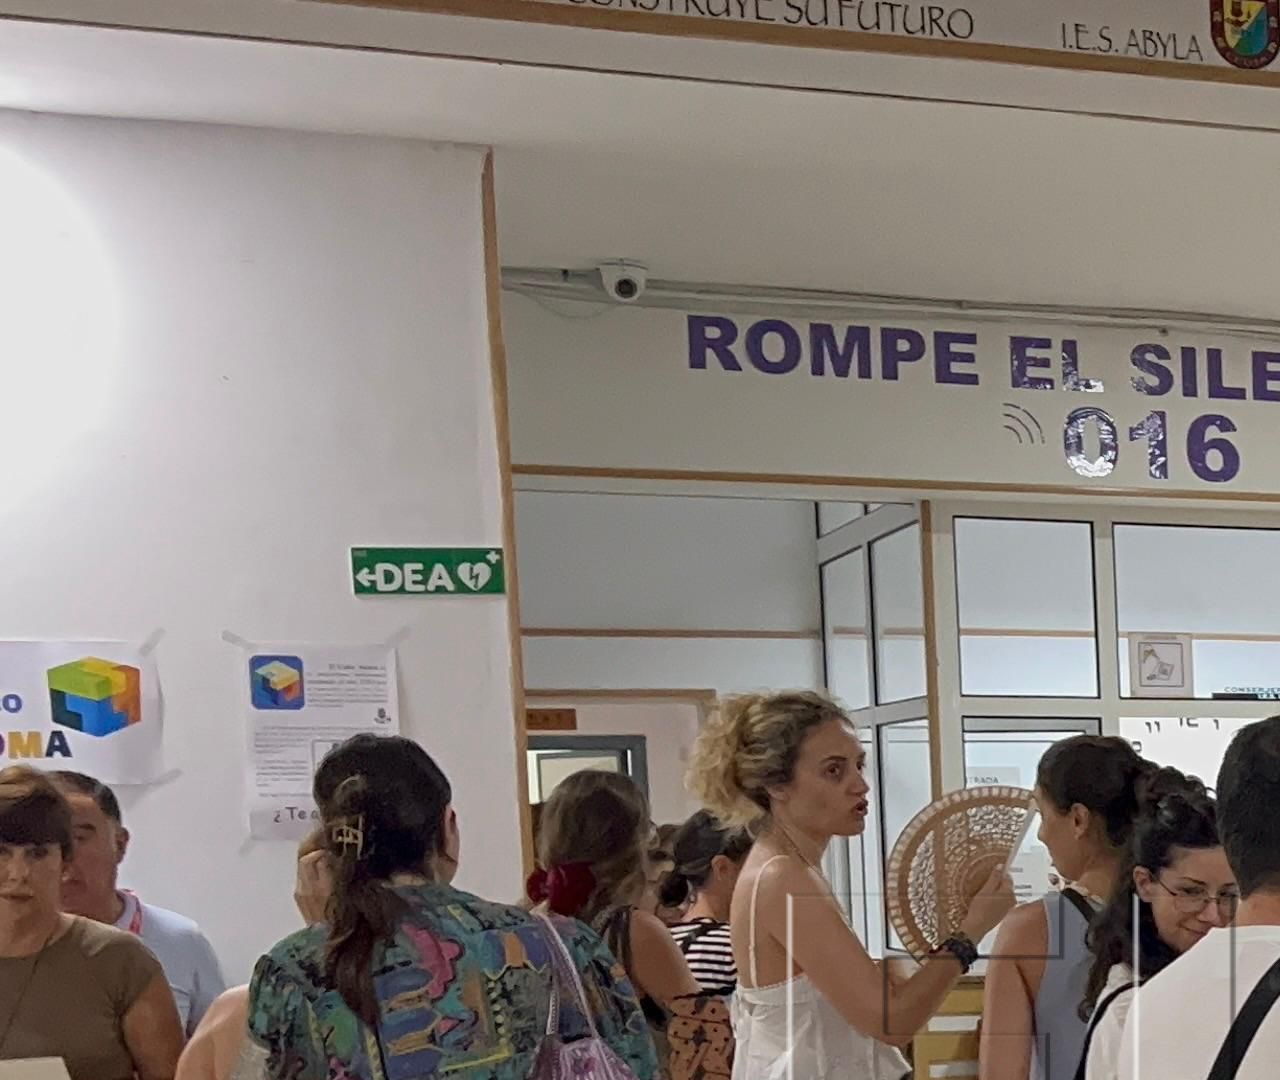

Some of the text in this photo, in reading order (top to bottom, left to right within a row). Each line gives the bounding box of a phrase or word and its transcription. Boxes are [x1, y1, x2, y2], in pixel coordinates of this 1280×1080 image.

[783, 0, 829, 26] SU
[838, 0, 975, 40] FUTURO
[1061, 22, 1119, 52] I.E.S.
[1123, 28, 1204, 62] ABYLA
[687, 314, 980, 387] ROMPE
[1009, 335, 1105, 395] EL
[1062, 405, 1241, 483] 016
[376, 562, 456, 592] DEA
